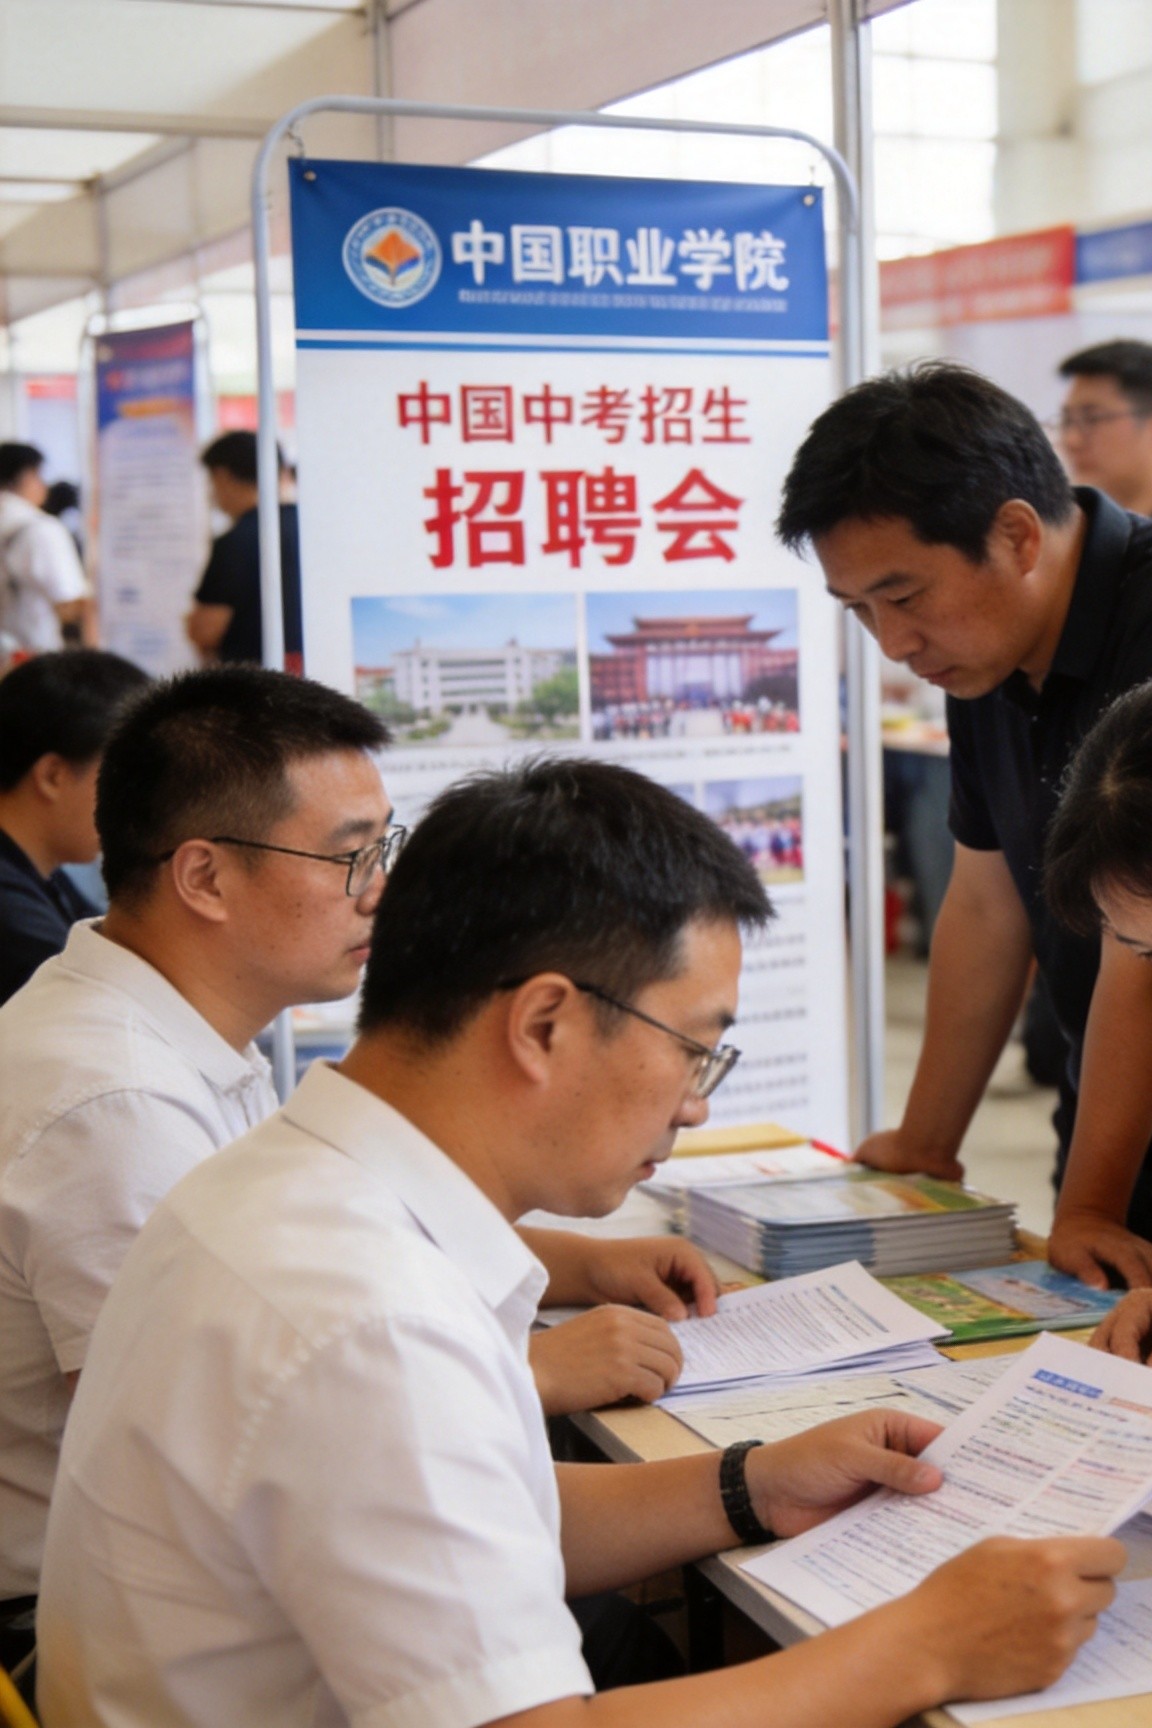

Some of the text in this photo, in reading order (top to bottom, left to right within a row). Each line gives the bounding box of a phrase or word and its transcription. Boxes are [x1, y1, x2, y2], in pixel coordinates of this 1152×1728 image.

[452, 220, 789, 292] 中国职业学院
[397, 380, 751, 445] 中国中考招生
[423, 466, 745, 568] 招聘会
